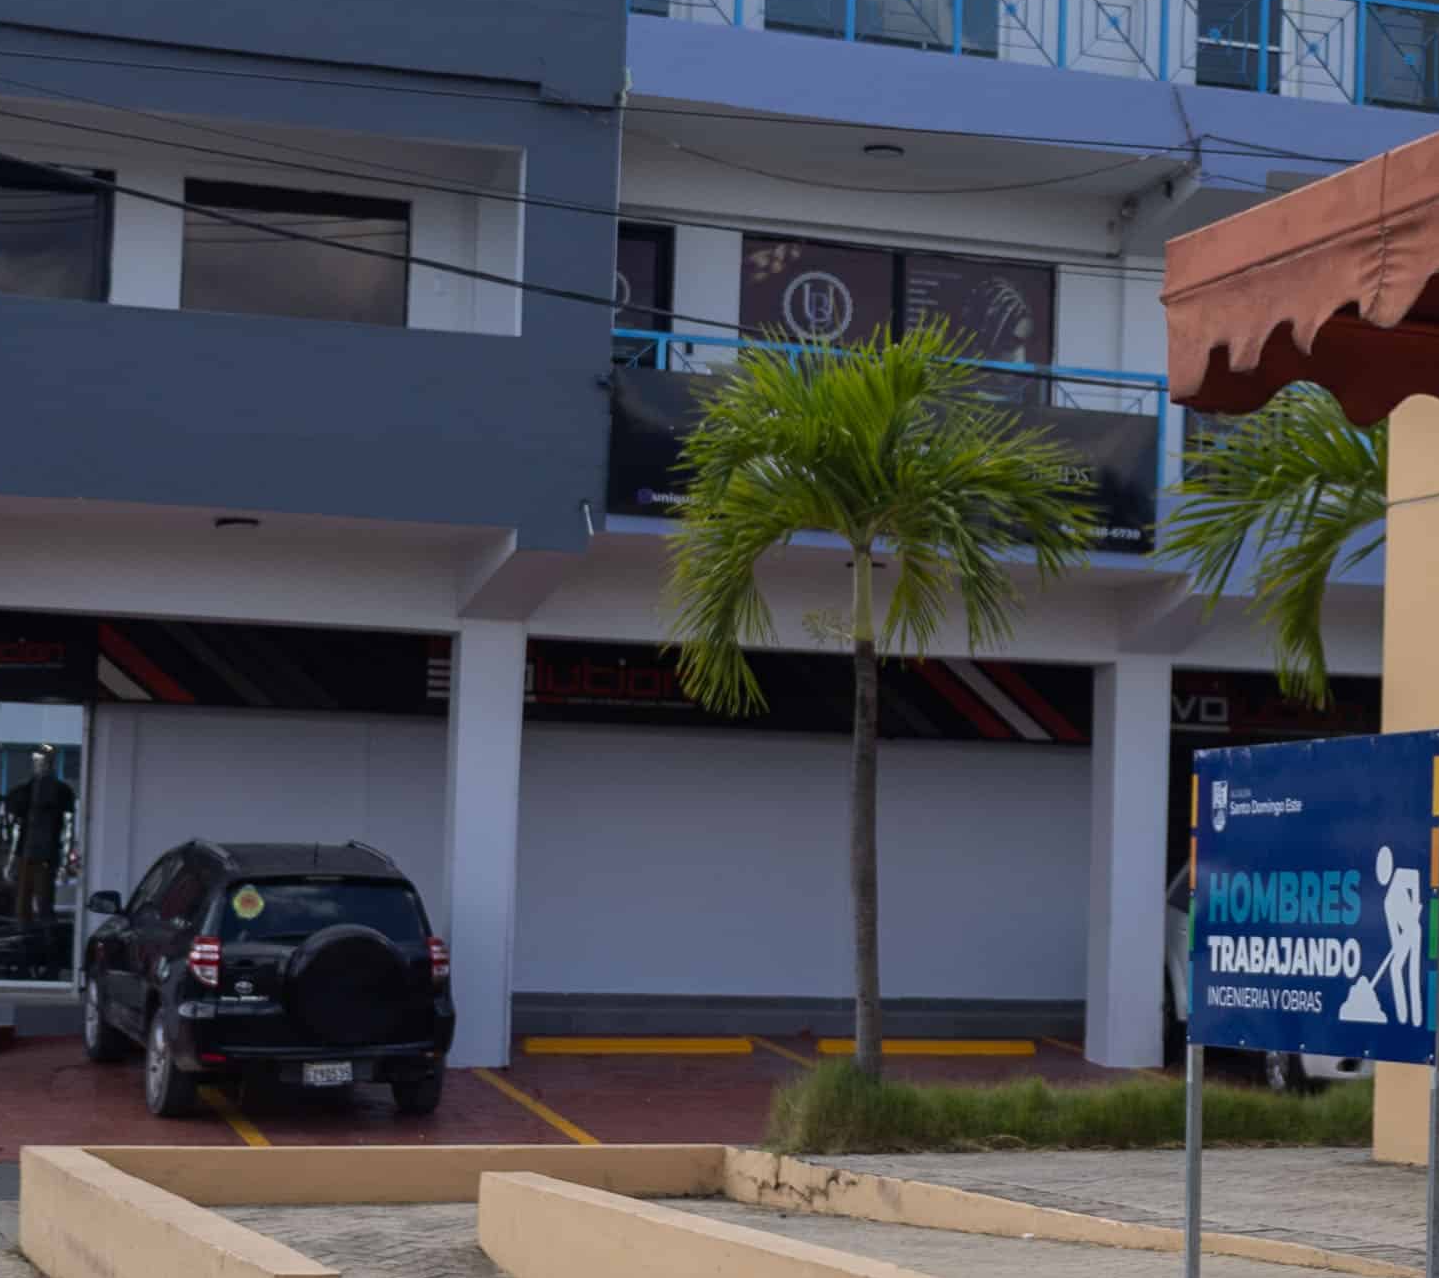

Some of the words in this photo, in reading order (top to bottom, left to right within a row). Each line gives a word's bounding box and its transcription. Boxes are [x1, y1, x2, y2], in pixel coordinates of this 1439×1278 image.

[1229, 800, 1251, 816] Santo
[1251, 798, 1284, 817] Domingo
[1209, 869, 1361, 926] HOMBRES
[1207, 935, 1361, 979] TRABAJANDO
[1207, 984, 1270, 1010] INGENIERIA
[1270, 988, 1281, 1010] Y
[1281, 989, 1322, 1014] OBRAS
